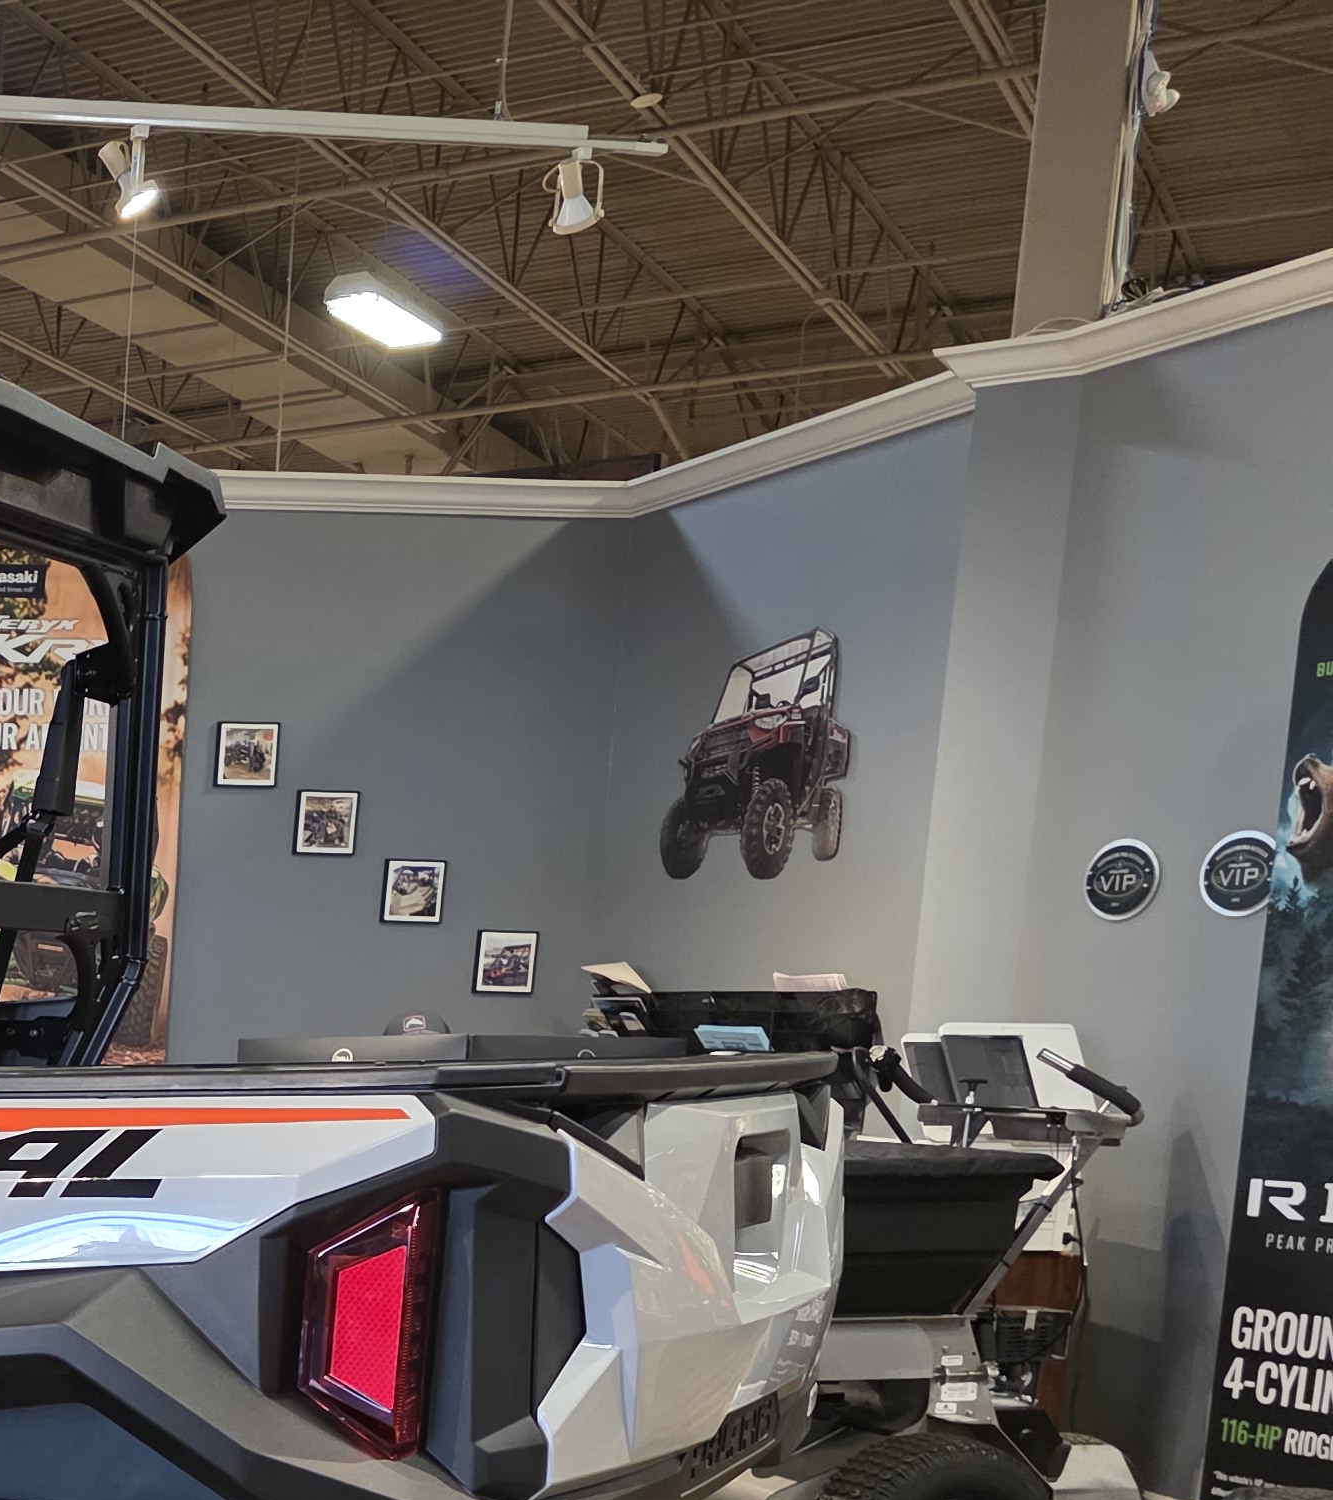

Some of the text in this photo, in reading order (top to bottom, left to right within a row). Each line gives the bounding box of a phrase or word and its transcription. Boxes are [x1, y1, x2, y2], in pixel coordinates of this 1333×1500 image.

[1100, 873, 1136, 892] VIP
[1219, 867, 1259, 887] VIP
[1265, 1233, 1307, 1251] PEAK
[1221, 1417, 1282, 1450] 116-HP
